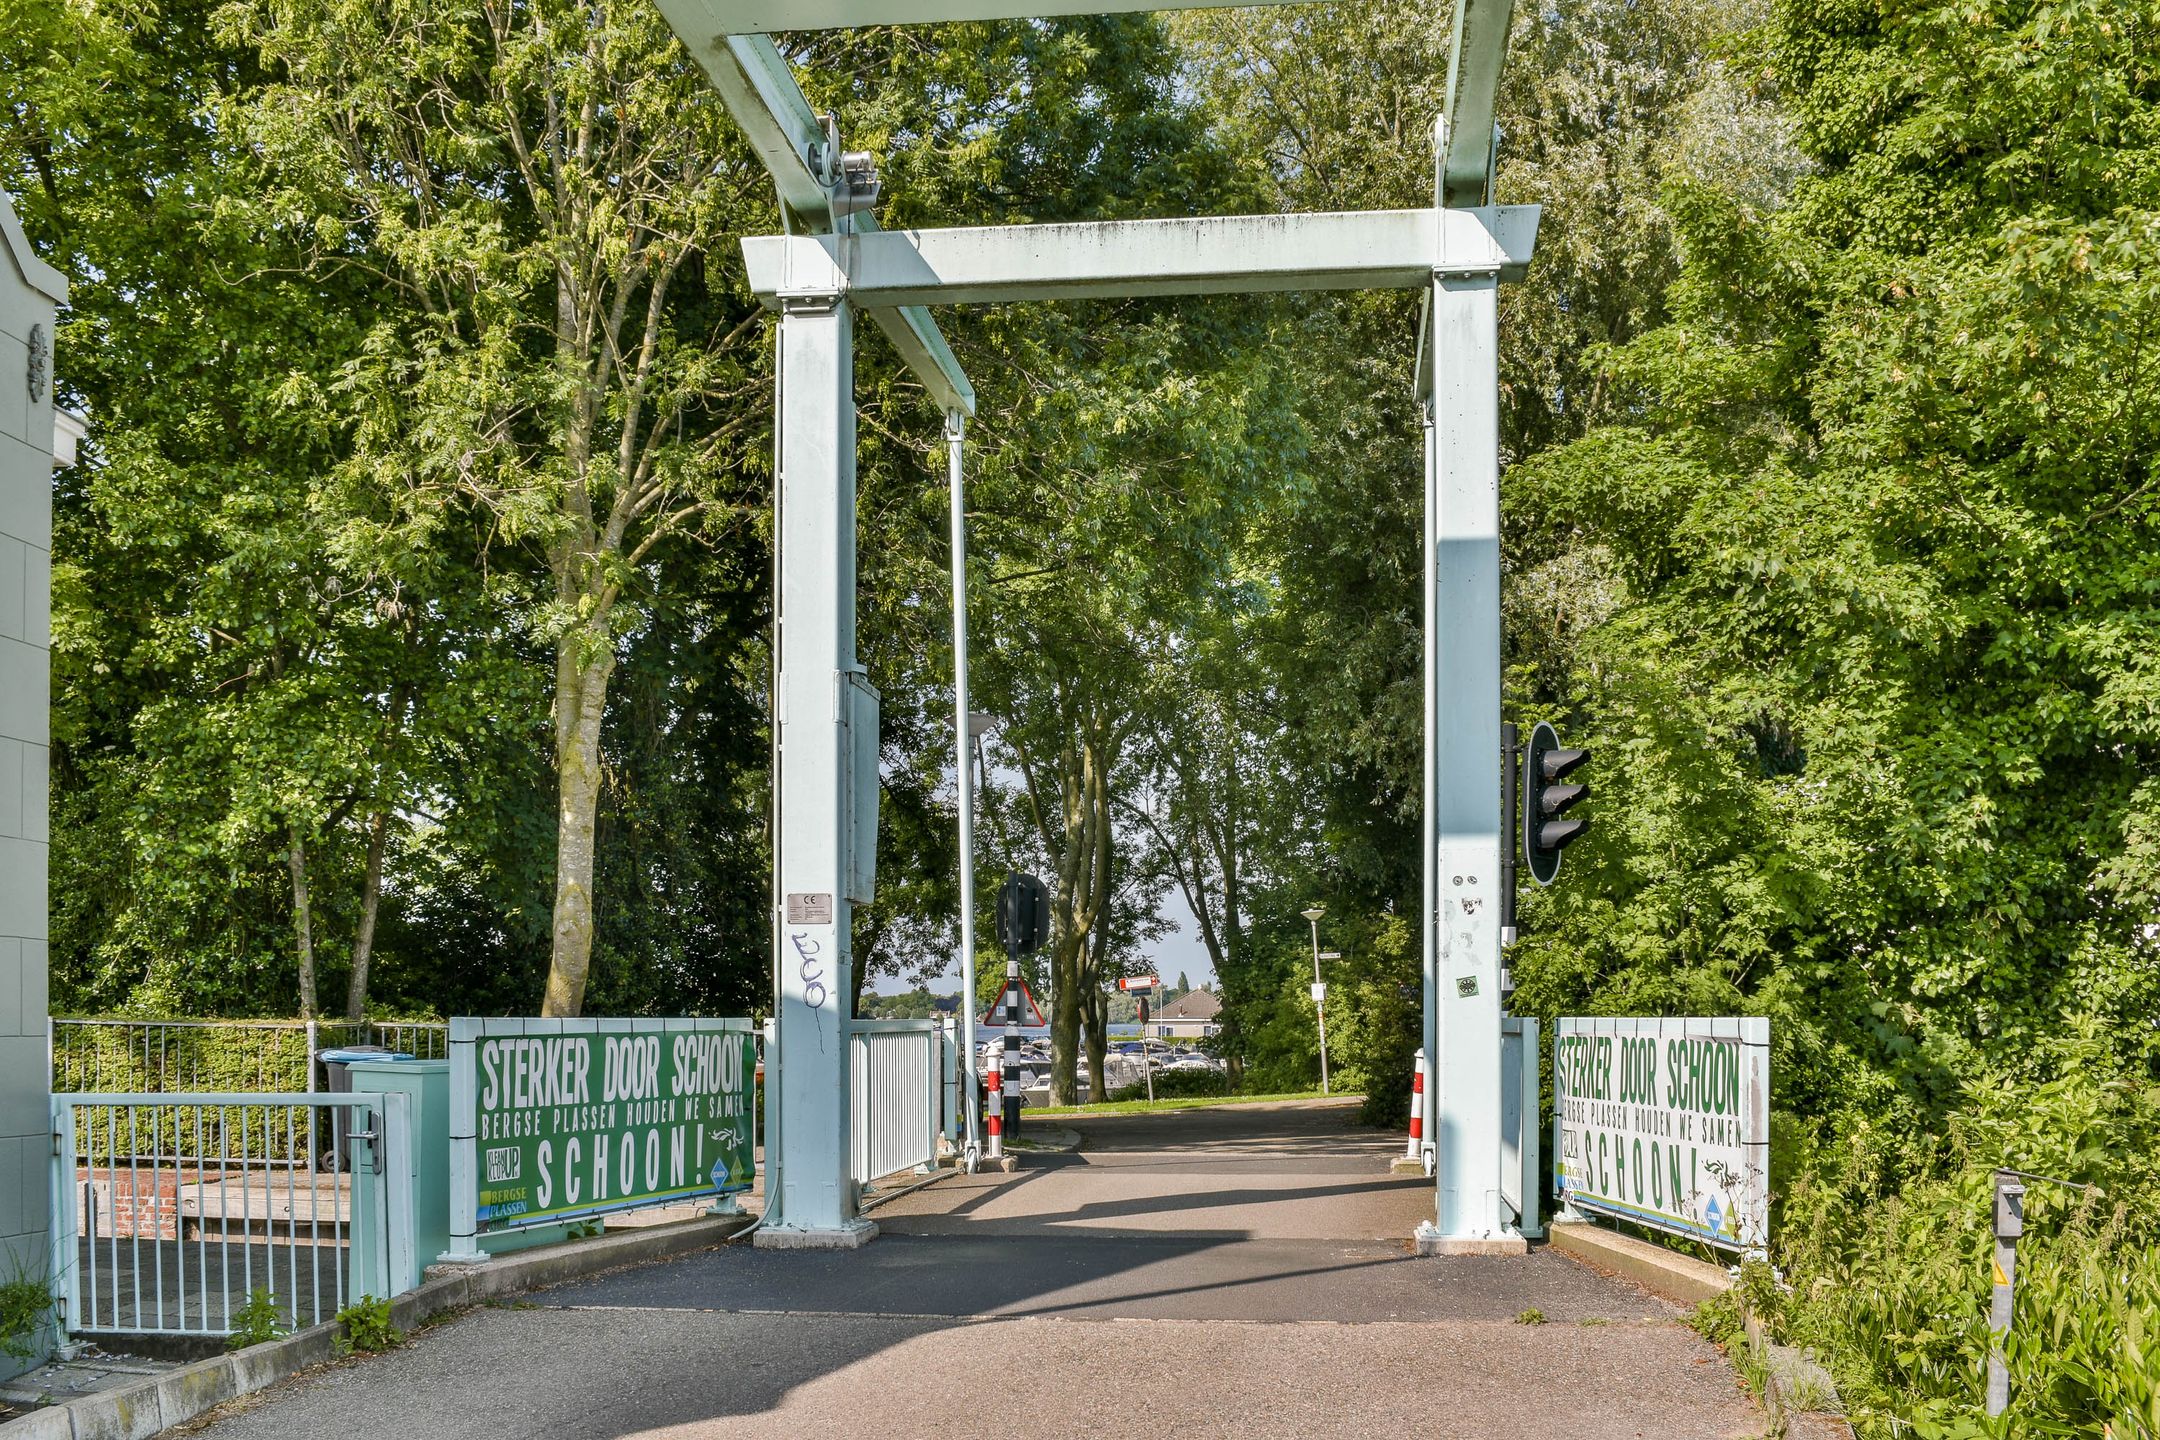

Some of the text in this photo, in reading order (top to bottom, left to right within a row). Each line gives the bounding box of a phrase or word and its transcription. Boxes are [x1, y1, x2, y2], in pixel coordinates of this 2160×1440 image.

[803, 895, 816, 905] CE
[482, 1034, 744, 1111] STERKER DOOR SCHOON
[1557, 1036, 1740, 1117] STERKER DOOR SCHOON
[481, 1094, 744, 1141] BERGSE PLASSEN HOUDEN WE SAMEN
[1591, 1102, 1628, 1130] PLASSEN
[1635, 1106, 1671, 1138] HOUDEN
[1679, 1113, 1692, 1141] WE
[1702, 1117, 1742, 1149] SAMEN
[504, 1147, 519, 1179] UP
[536, 1123, 704, 1209] SCHOON!
[1585, 1130, 1698, 1221] SCHOON!
[490, 1201, 527, 1218] PLASSEN
[491, 1186, 528, 1204] BERGSE
